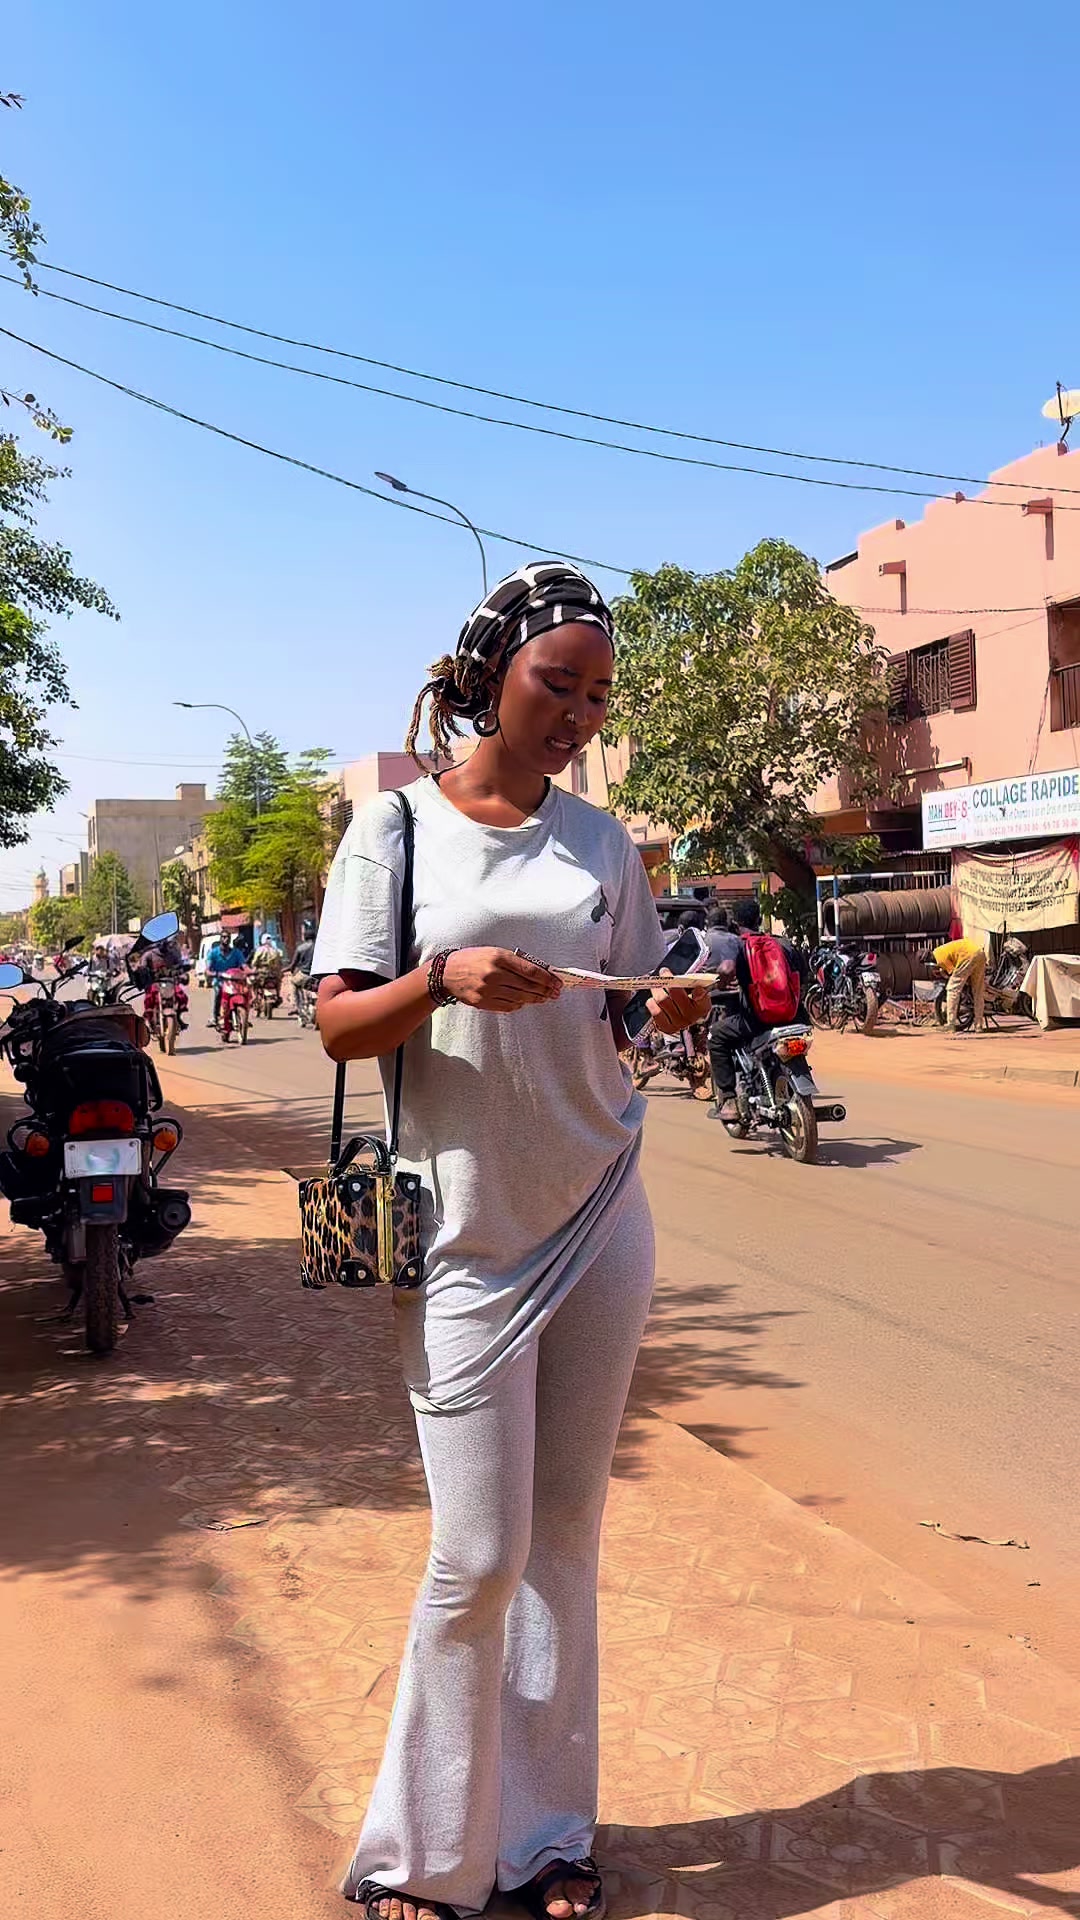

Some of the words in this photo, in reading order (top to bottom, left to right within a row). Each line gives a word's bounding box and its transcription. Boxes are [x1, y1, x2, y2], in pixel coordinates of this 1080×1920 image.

[972, 781, 1027, 809] COLLAGE
[1031, 774, 1079, 801] RAPIDE
[927, 803, 943, 820] MAH
